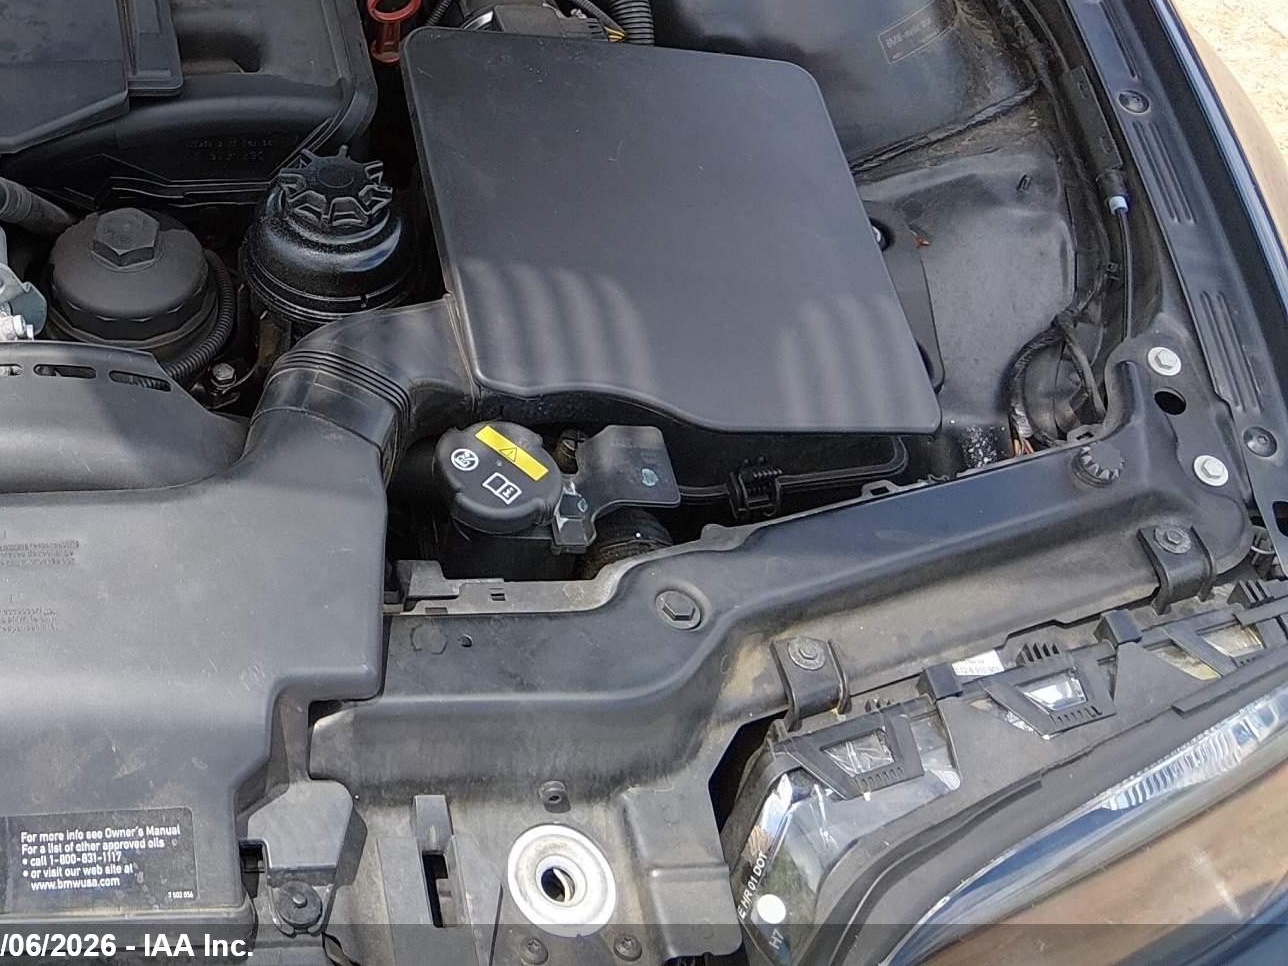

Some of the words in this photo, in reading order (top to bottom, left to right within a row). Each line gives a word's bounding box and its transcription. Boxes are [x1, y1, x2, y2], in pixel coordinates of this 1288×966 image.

[21, 832, 37, 843] For
[40, 832, 64, 842] more
[67, 829, 84, 840] info
[86, 830, 102, 840] see
[146, 824, 180, 836] Manual
[21, 844, 37, 855] For
[40, 845, 46, 854] a
[48, 842, 62, 853] list
[65, 842, 73, 852] of
[76, 841, 100, 852] other
[103, 838, 145, 852] approved
[148, 838, 165, 847] oils
[30, 856, 47, 865] call
[50, 852, 121, 865] 1-800-831-1117
[31, 869, 41, 879] or
[43, 866, 62, 877] visit
[65, 867, 80, 876] our
[83, 864, 102, 876] web
[105, 864, 121, 874] site
[124, 864, 133, 873] at
[741, 889, 752, 909] HR
[748, 876, 758, 891] 01
[753, 850, 767, 876] DOT
[31, 877, 120, 890] www.bmwusa.com
[769, 928, 784, 949] H7
